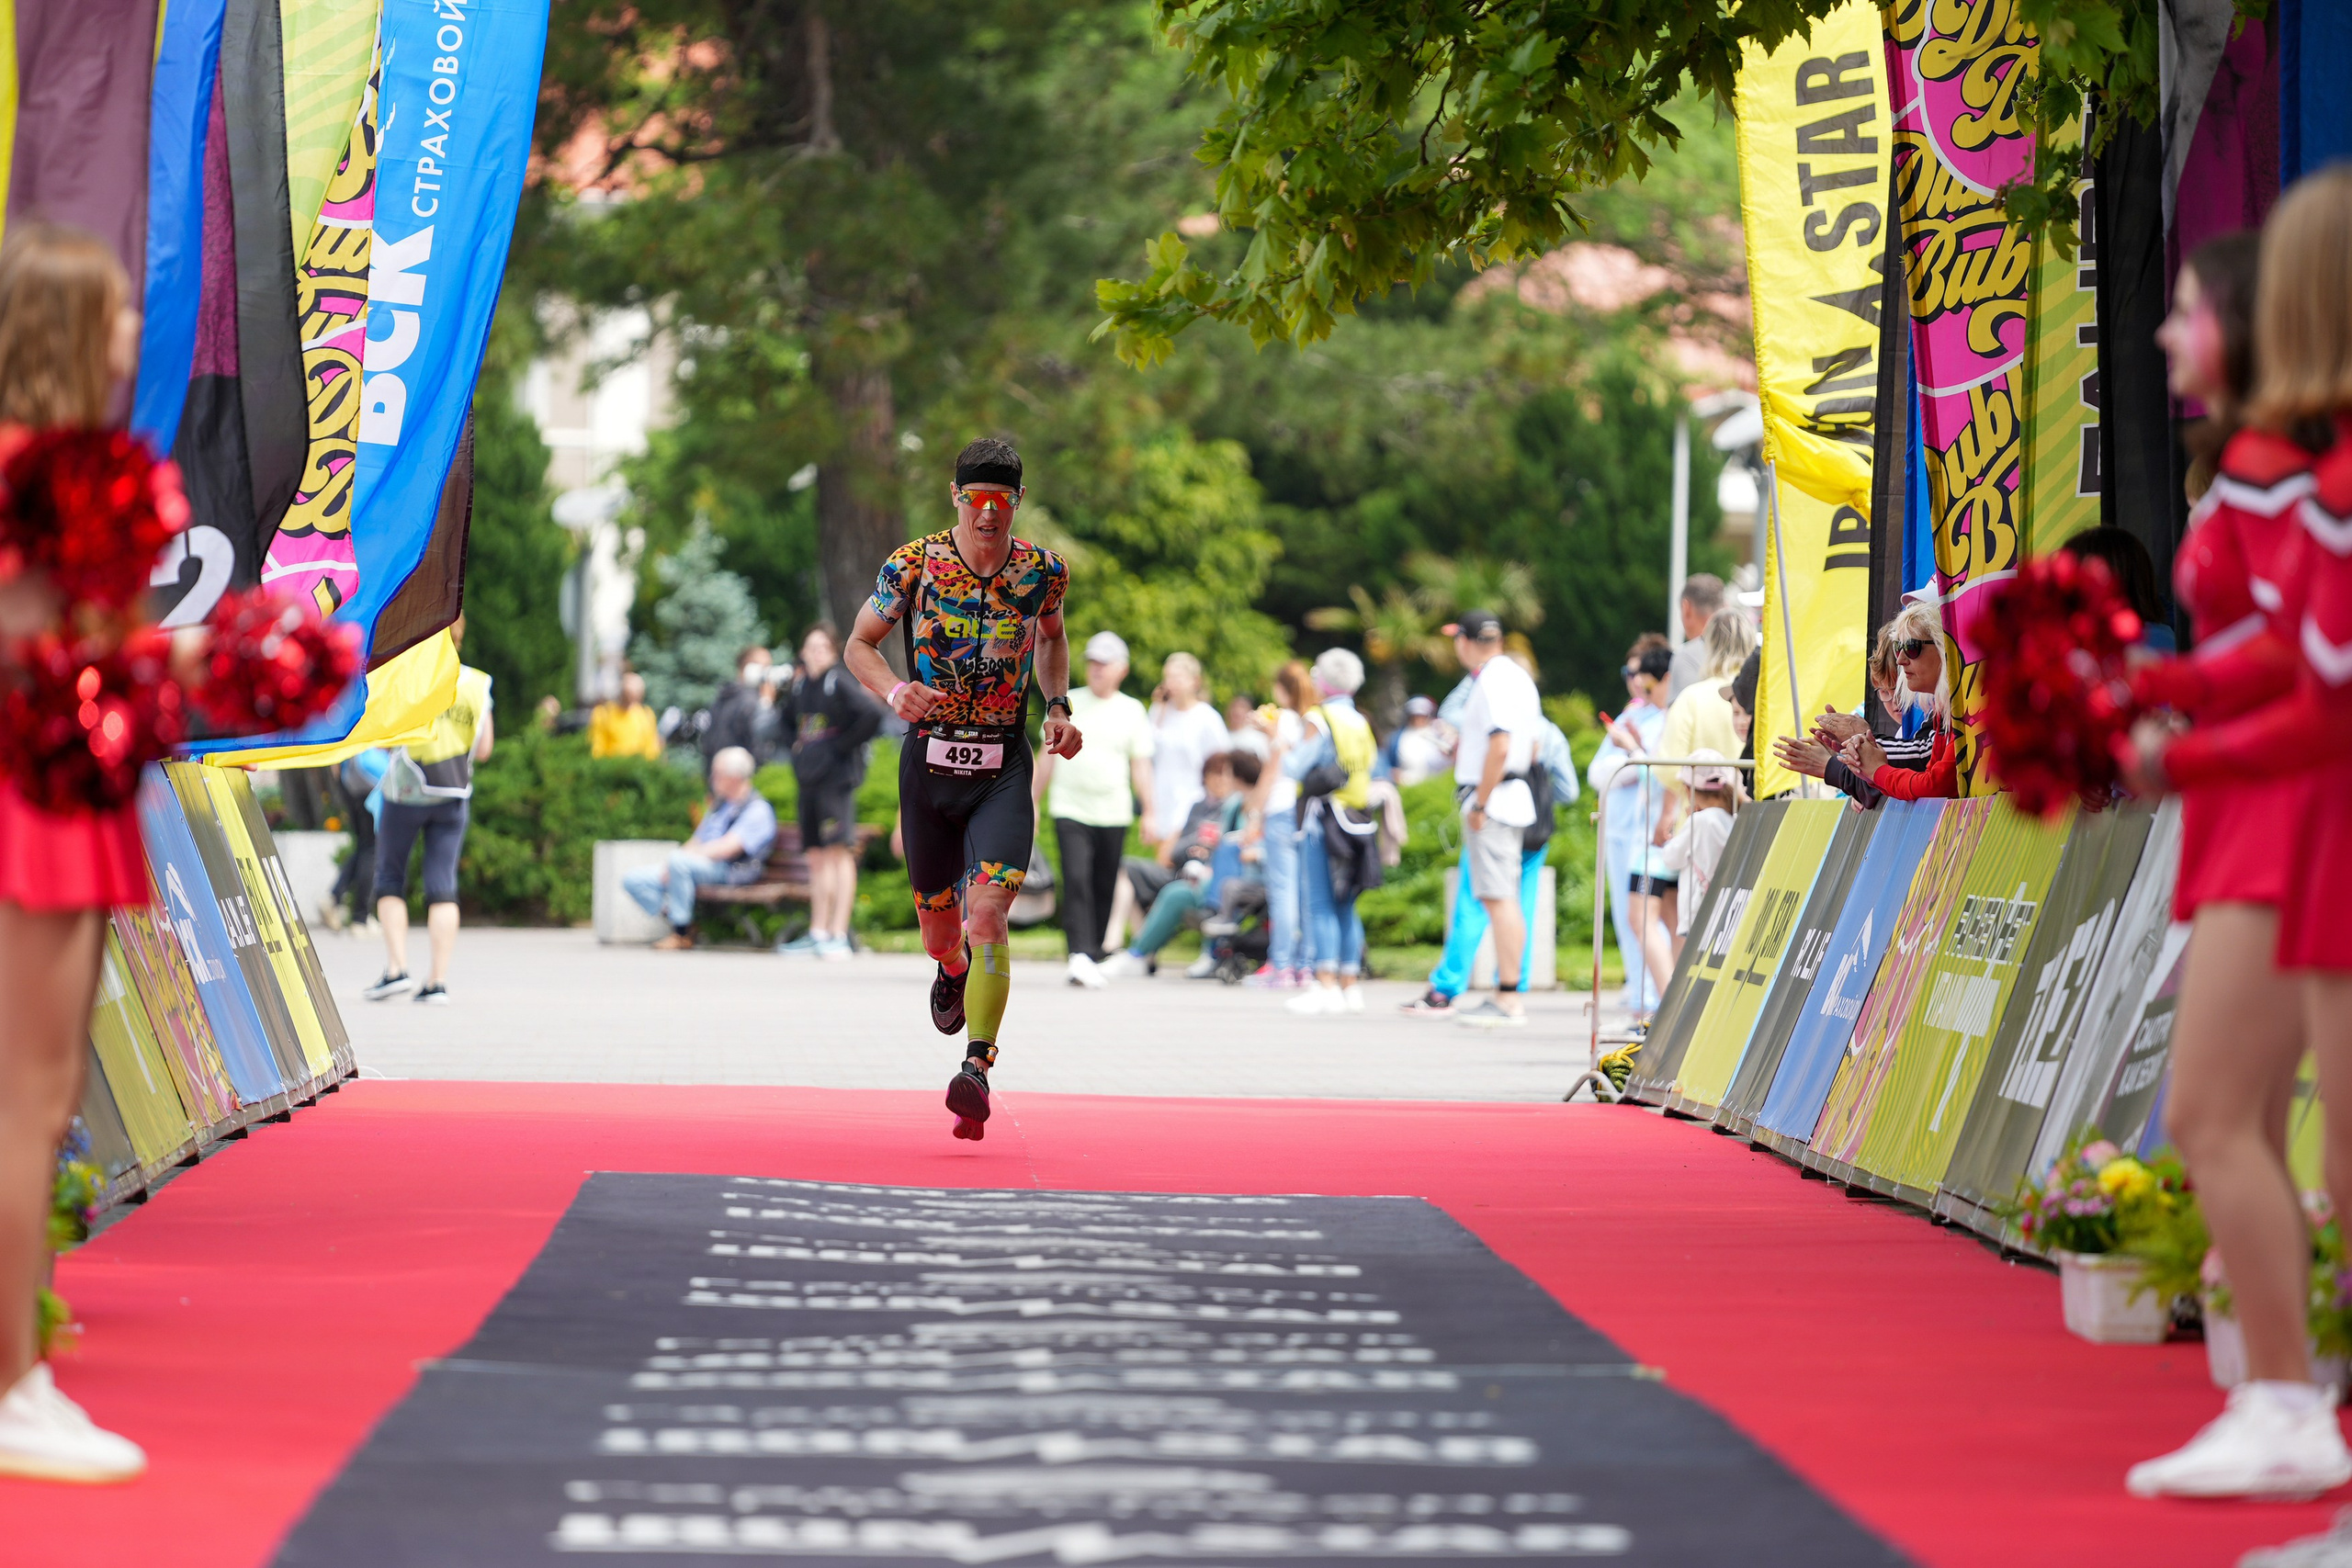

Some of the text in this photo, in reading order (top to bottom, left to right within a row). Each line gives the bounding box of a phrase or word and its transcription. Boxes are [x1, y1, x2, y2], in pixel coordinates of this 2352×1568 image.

[1795, 50, 1881, 253] STAR
[356, 224, 435, 446] ВСК
[945, 746, 984, 765] 492
